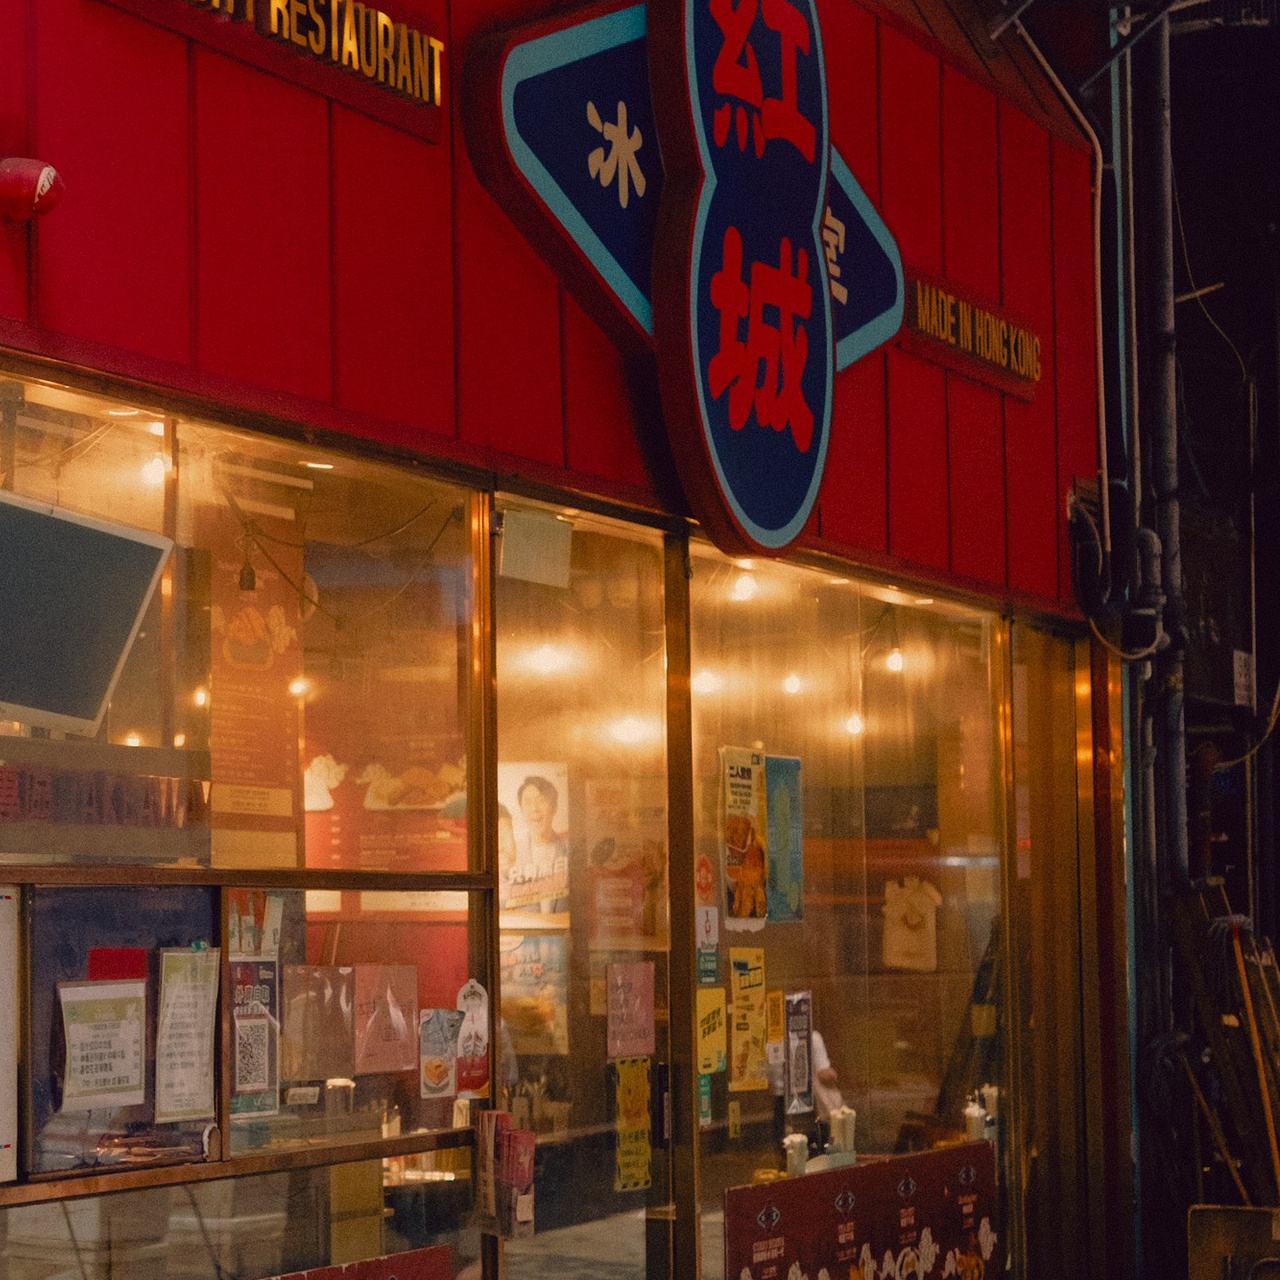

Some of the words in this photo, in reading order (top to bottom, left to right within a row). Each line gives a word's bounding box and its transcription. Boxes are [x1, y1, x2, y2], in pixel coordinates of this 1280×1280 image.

[584, 99, 647, 210] 冰
[916, 280, 957, 345] MADE
[959, 300, 972, 352] IN
[975, 307, 1008, 368] HONG
[1010, 323, 1042, 382] KONG
